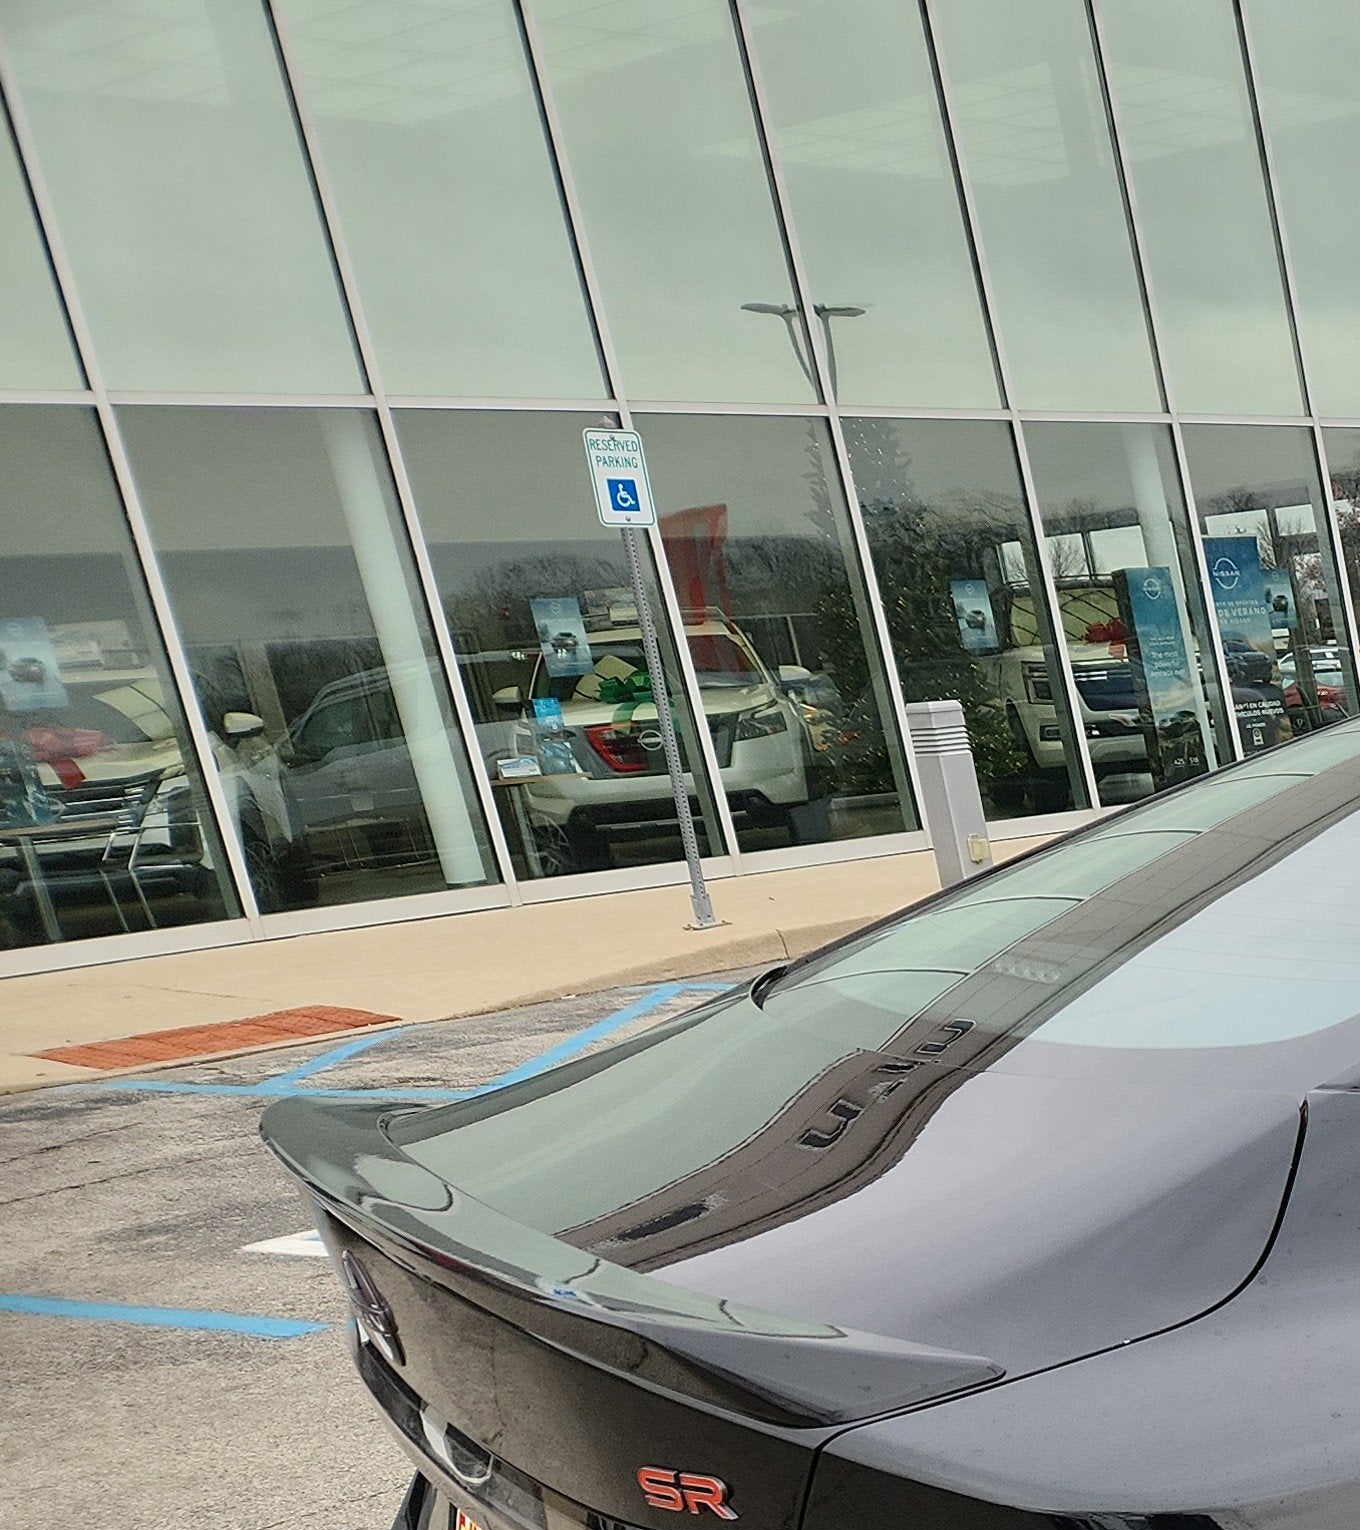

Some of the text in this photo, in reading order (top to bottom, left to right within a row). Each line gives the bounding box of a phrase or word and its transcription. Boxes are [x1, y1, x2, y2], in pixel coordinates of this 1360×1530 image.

[588, 438, 638, 452] RESERVED
[595, 455, 639, 469] PARKING
[1217, 607, 1267, 618] DE VERANO
[637, 1466, 739, 1521] SR
